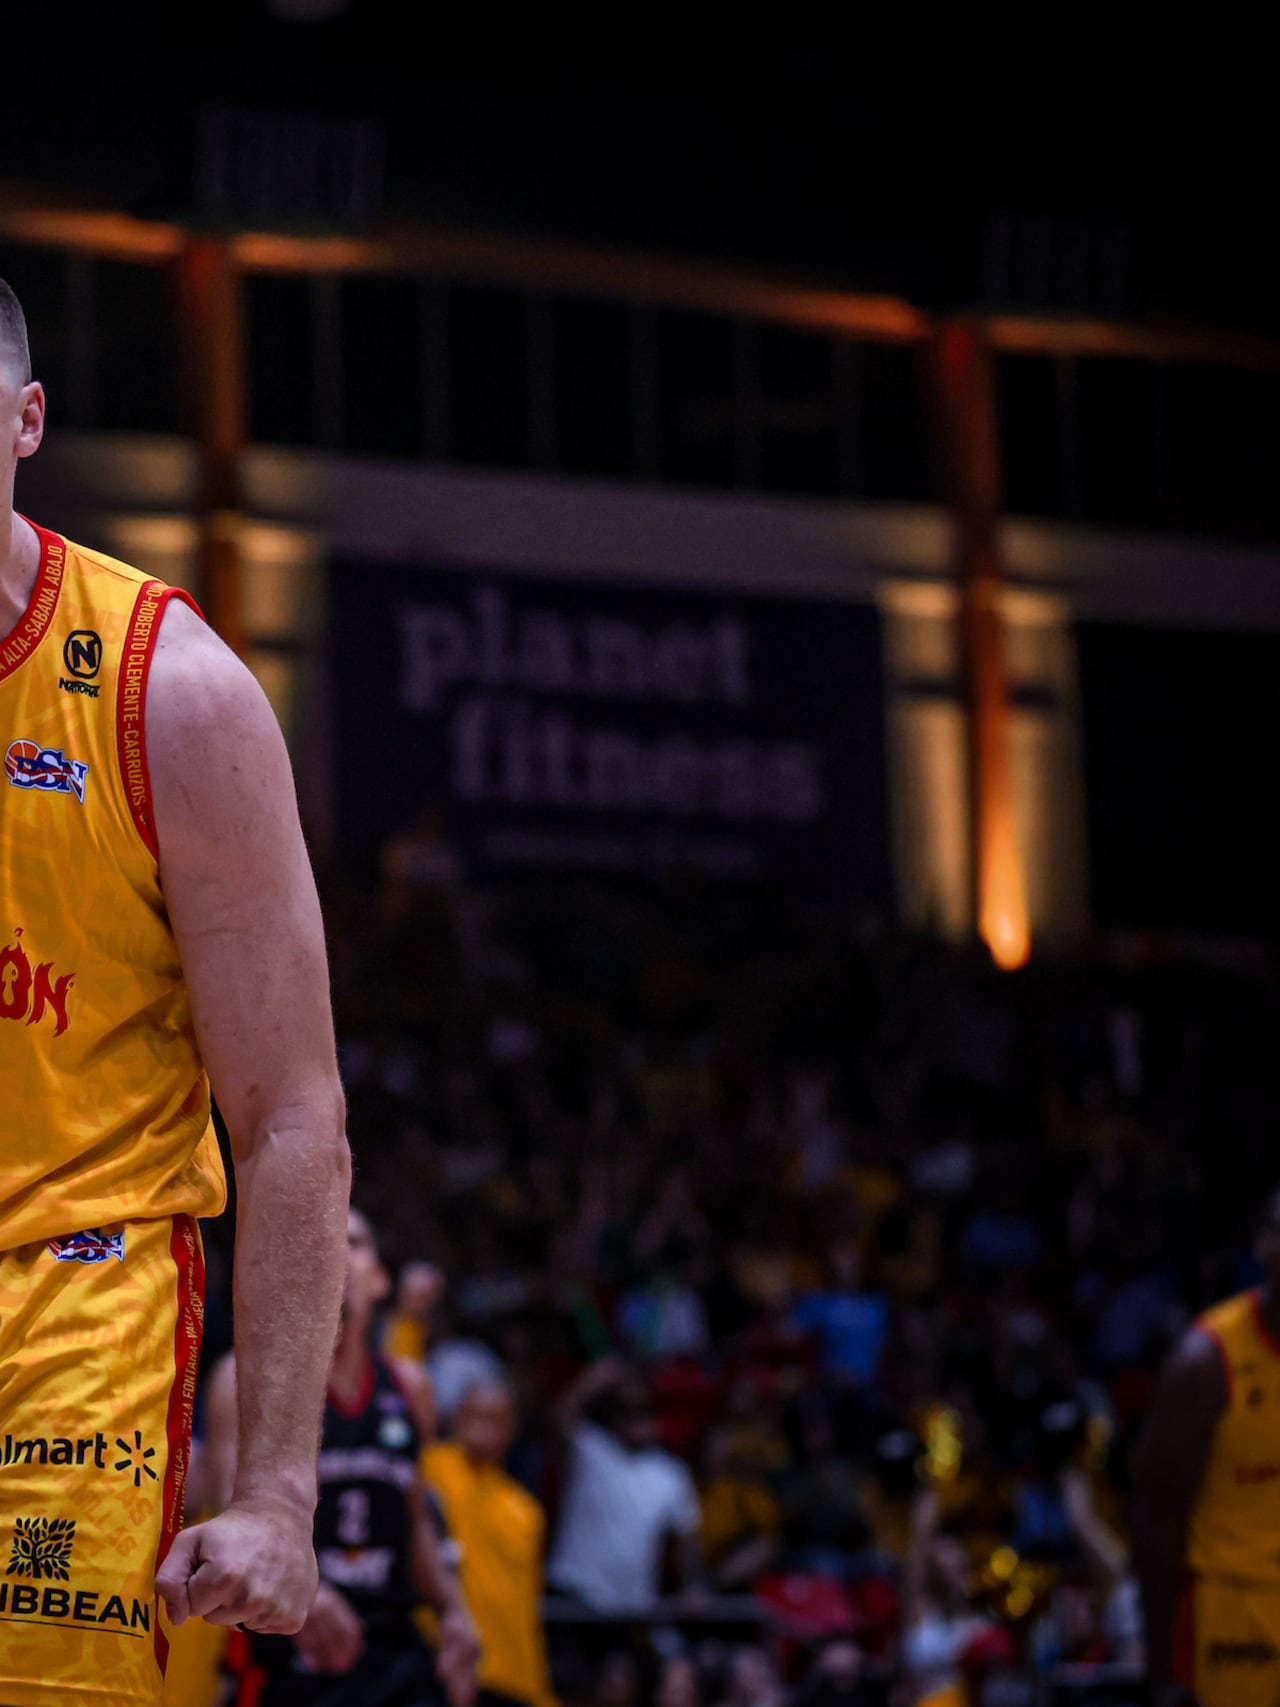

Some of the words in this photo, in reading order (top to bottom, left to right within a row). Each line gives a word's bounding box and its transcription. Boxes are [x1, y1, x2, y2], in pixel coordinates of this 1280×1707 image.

[5, 588, 58, 667] ALTA-SABANA
[44, 544, 64, 586] ABAJO
[131, 587, 163, 650] O-ROBERTO
[395, 580, 755, 712] planet
[449, 694, 823, 825] fitness
